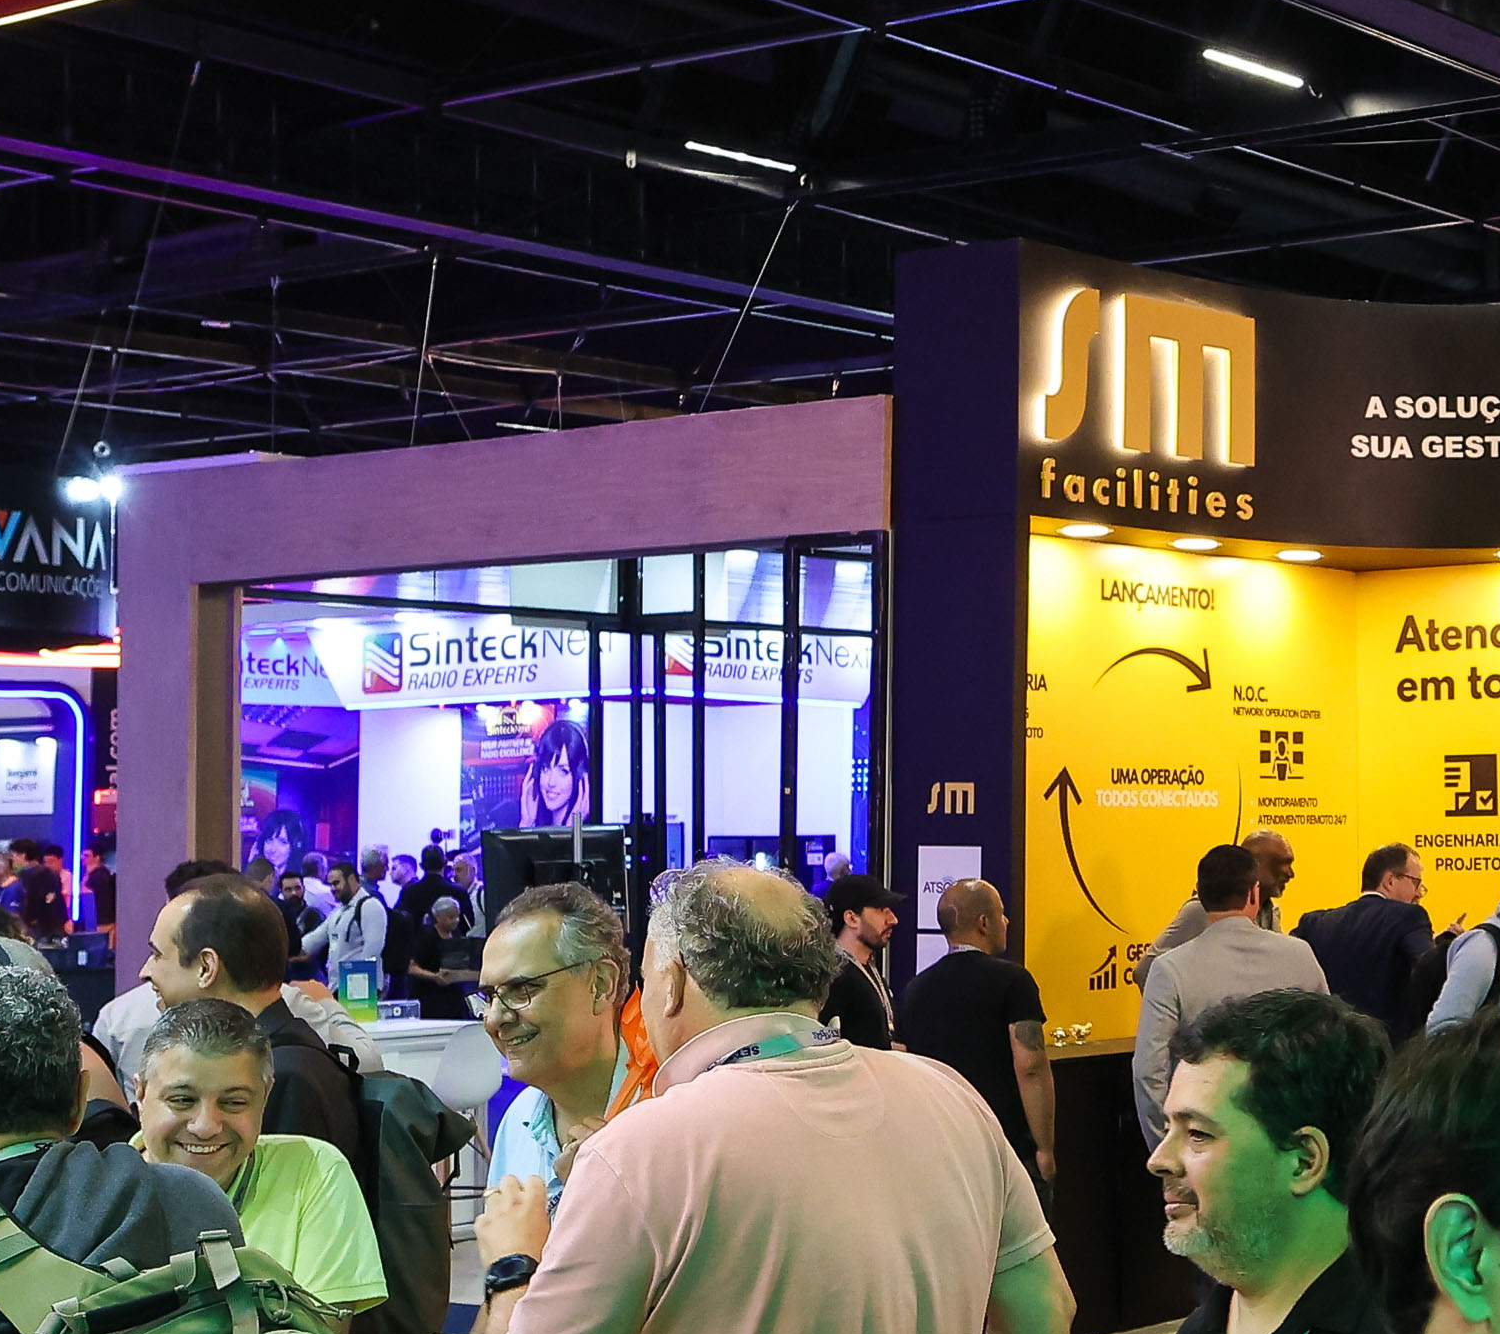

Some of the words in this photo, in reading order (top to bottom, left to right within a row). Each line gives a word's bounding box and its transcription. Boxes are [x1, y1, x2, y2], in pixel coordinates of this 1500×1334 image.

[1366, 394, 1397, 420] A
[1350, 433, 1413, 460] SUA
[1040, 457, 1255, 522] facilities
[1100, 578, 1215, 612] LANÇAMENTO!
[408, 669, 458, 692] RADIO
[463, 663, 539, 688] EXPERTS
[1396, 673, 1455, 704] em
[1111, 767, 1139, 786] UMA
[1140, 764, 1205, 791] OPERAÇÃO
[1095, 788, 1138, 809] TODOS
[1138, 789, 1219, 809] CONECTADOS
